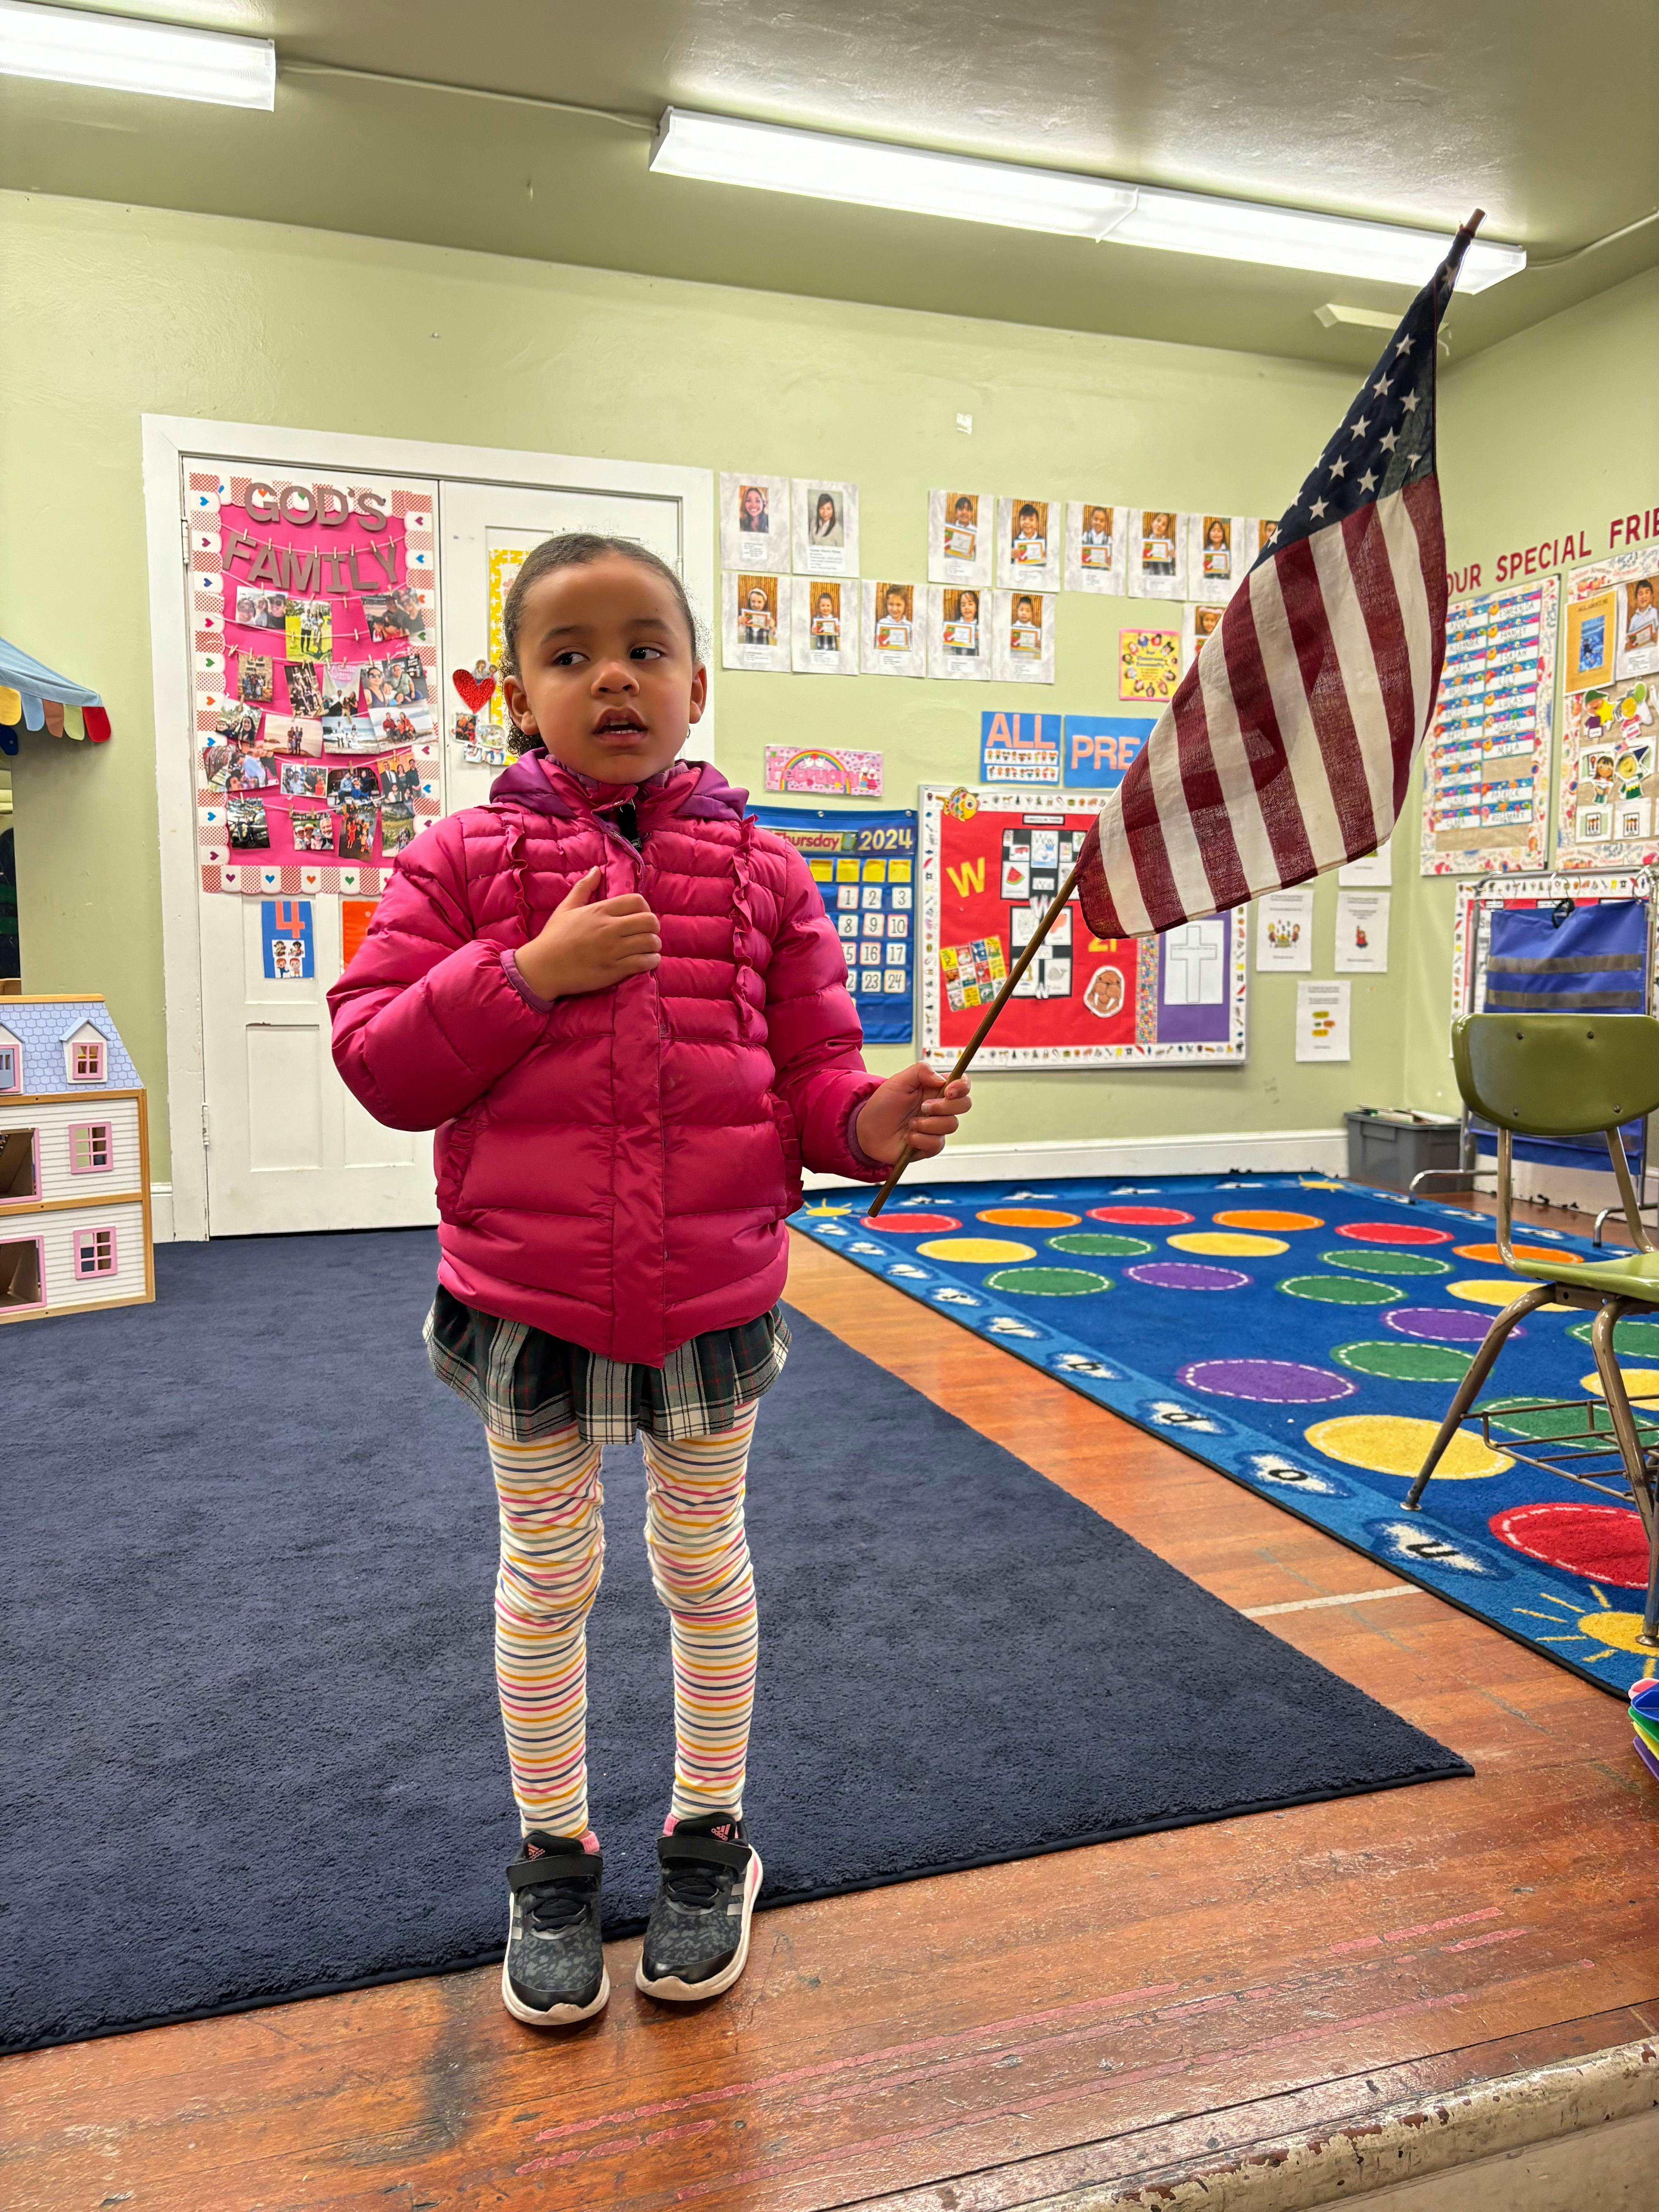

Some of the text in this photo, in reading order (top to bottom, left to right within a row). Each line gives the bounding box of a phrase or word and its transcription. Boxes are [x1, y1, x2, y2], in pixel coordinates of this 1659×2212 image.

[244, 482, 386, 532] GOD'S
[222, 531, 397, 593] FAMILY
[1446, 563, 1481, 598] OUR
[1496, 531, 1592, 582] SPECIAL
[986, 713, 1055, 749] ALL
[769, 756, 860, 788] February
[858, 829, 913, 851] 2024
[946, 857, 985, 898] W
[845, 890, 906, 905] 1 2 3
[275, 902, 305, 938] 4
[844, 917, 905, 933] 8 9 10
[842, 946, 903, 961] 5 16 17
[865, 974, 879, 989] 23
[888, 974, 902, 989] 24
[1269, 1468, 1309, 1481] o
[1405, 1542, 1460, 1559] u
[711, 1828, 728, 1841] adidas
[529, 1849, 545, 1861] adidas
